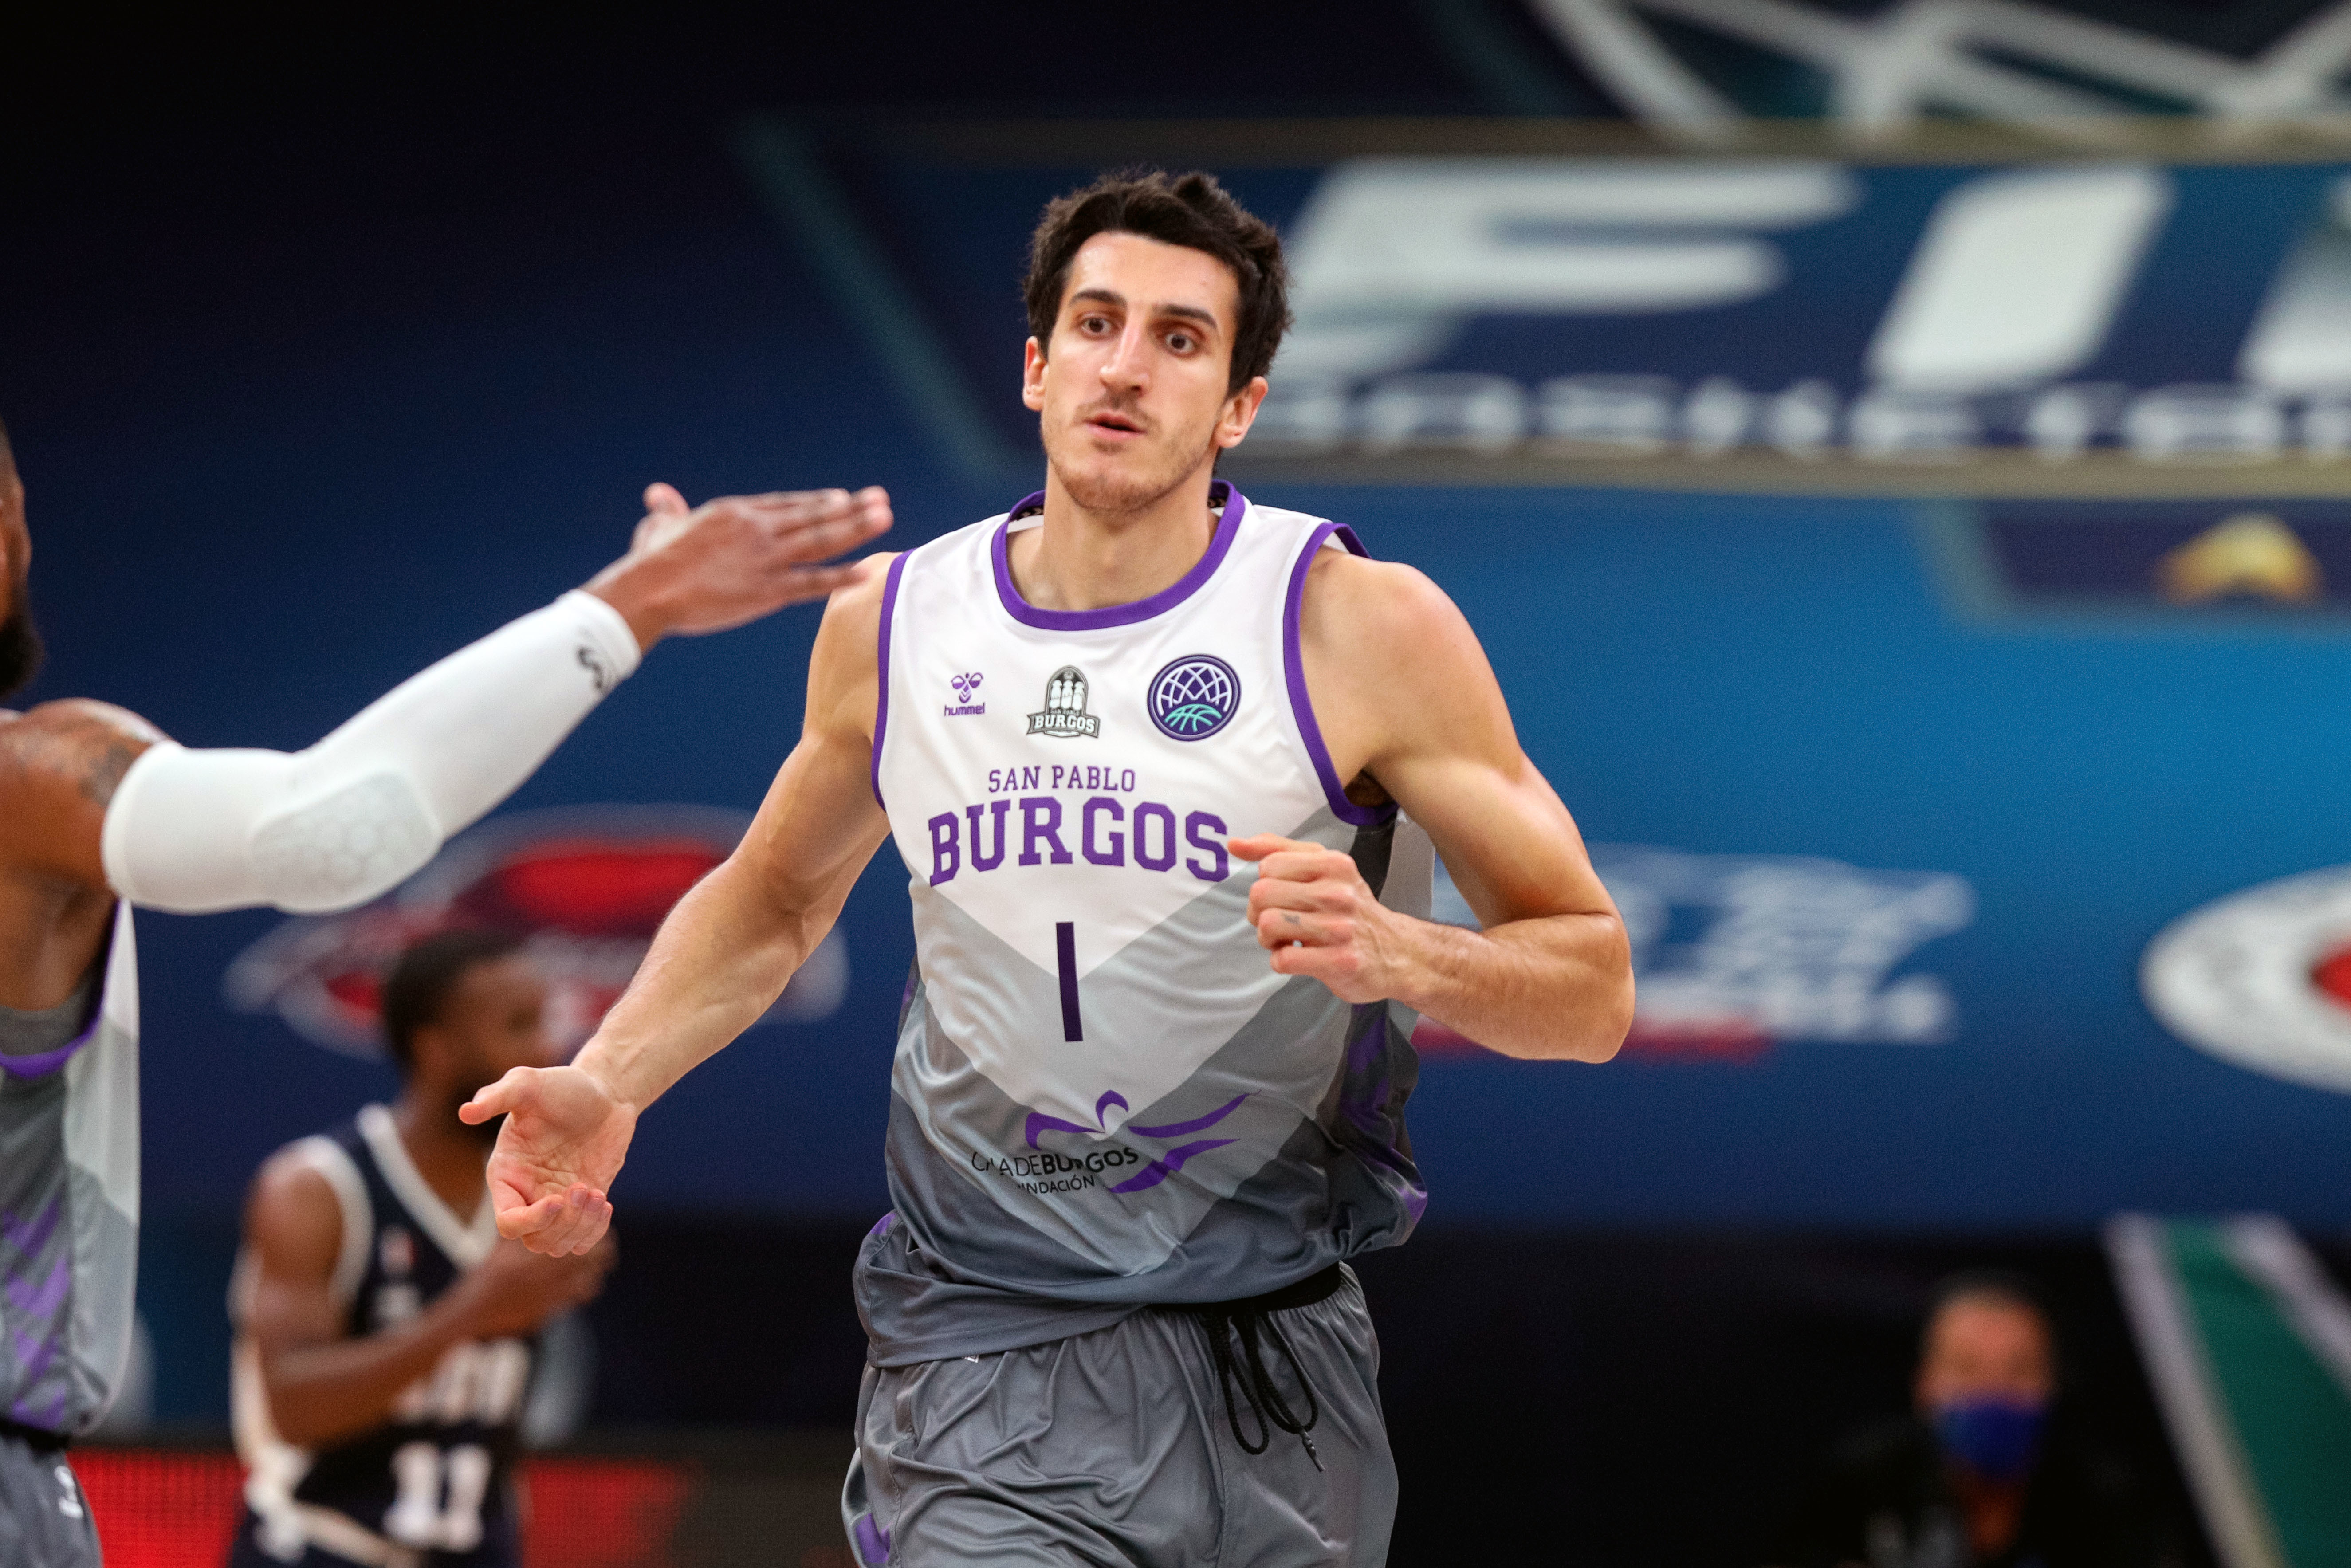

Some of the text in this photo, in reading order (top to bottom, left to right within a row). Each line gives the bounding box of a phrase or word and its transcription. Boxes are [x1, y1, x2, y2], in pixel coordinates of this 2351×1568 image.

[944, 703, 985, 716] hummel
[1034, 714, 1095, 733] BURGOS
[988, 765, 1136, 793] SAN PABLO
[928, 797, 1230, 887] BURGOS
[1056, 921, 1083, 1041] 1
